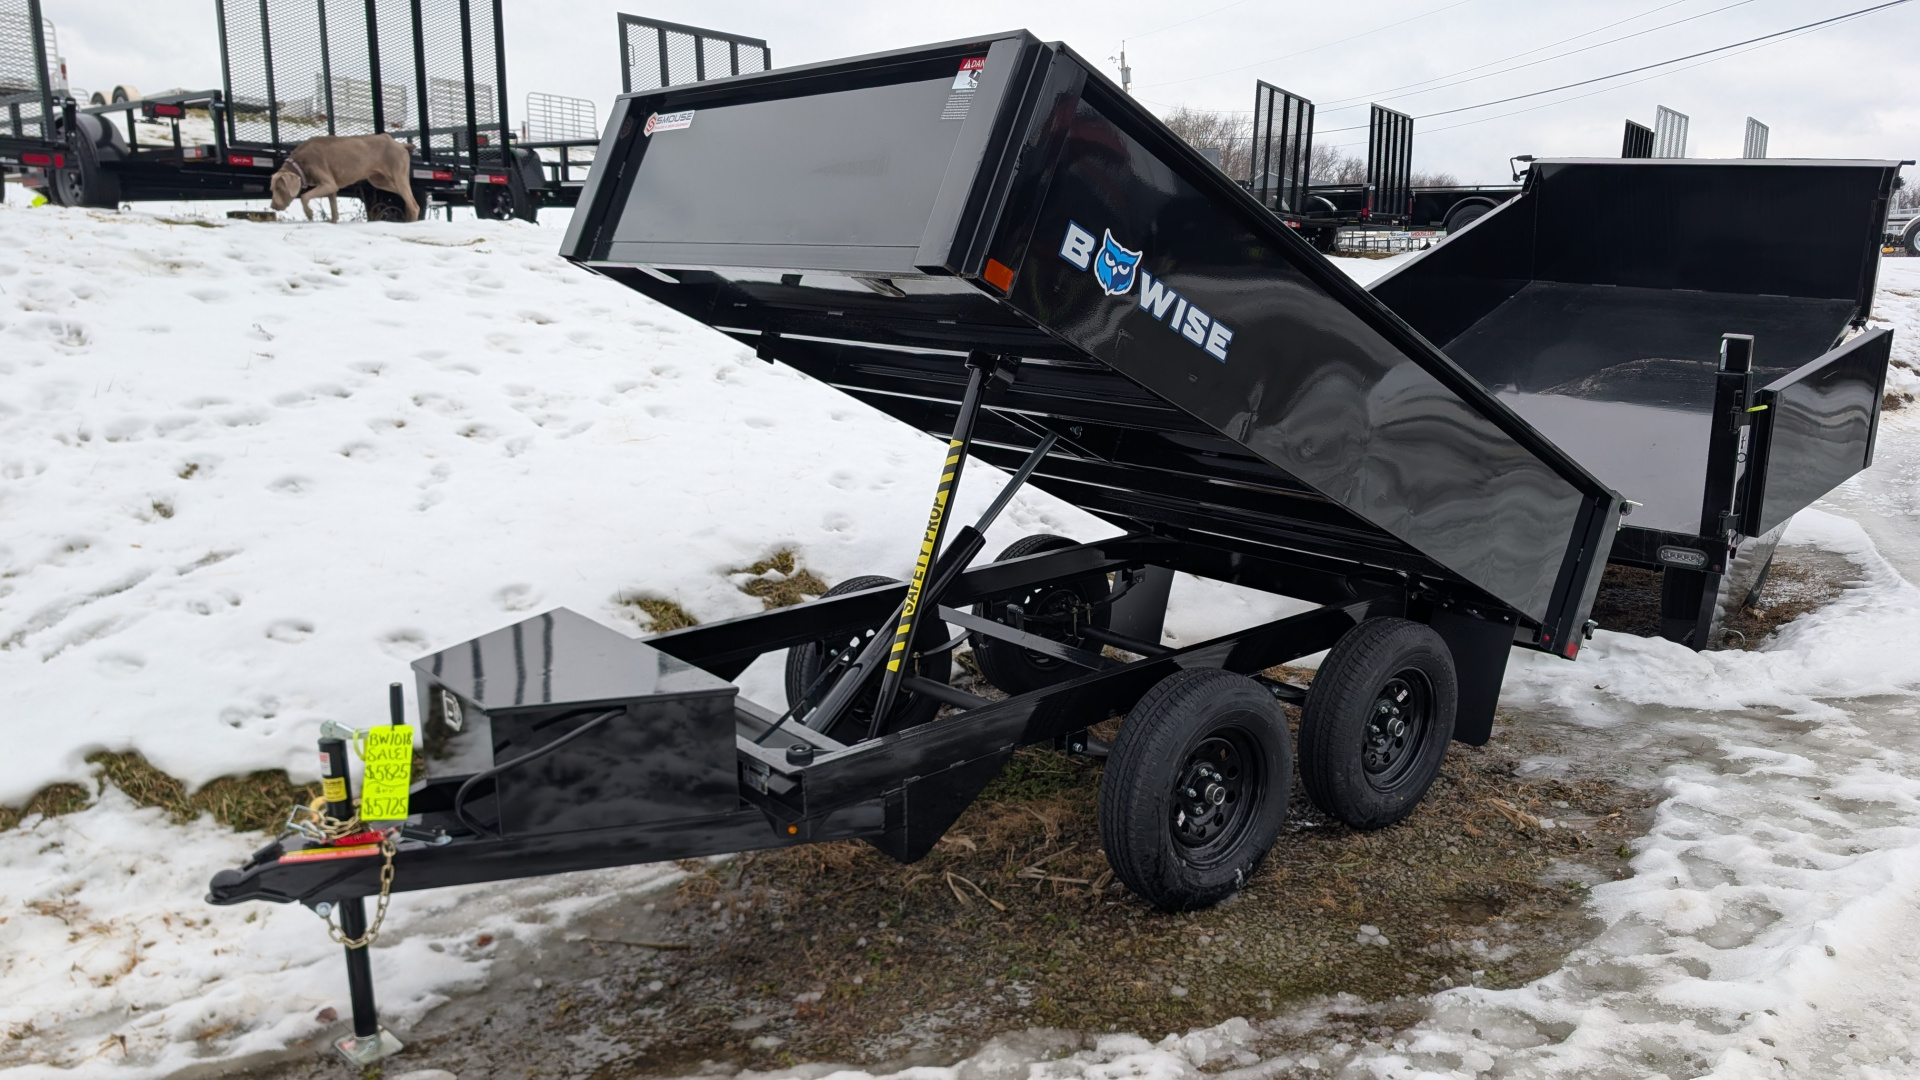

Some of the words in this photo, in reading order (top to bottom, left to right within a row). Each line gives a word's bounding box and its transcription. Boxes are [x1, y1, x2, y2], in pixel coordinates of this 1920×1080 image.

[656, 112, 694, 125] SMOUSE
[923, 496, 944, 543] PROP
[365, 763, 411, 781] $5825
[363, 797, 407, 817] $5725
